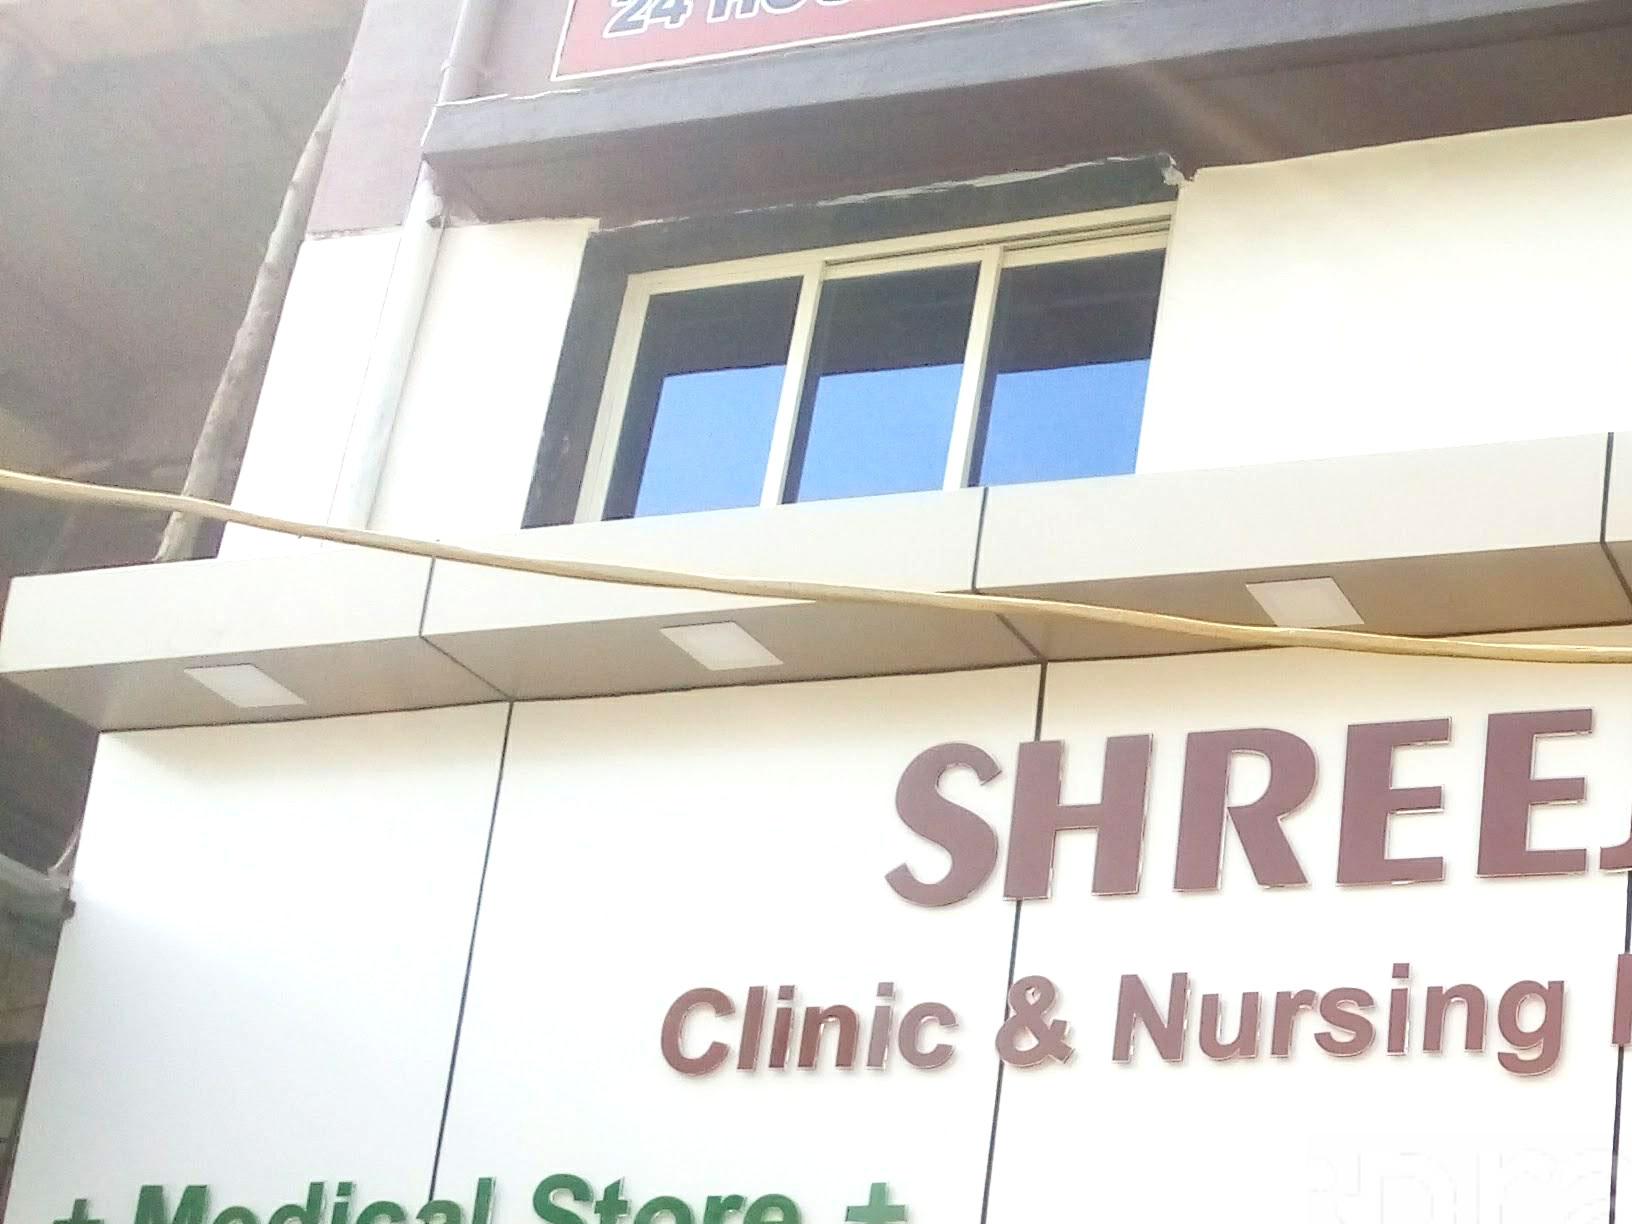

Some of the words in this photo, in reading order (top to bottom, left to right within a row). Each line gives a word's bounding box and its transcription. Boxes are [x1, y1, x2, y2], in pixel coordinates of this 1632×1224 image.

[661, 982, 958, 1078] Clinic
[995, 976, 1075, 1070] &
[1112, 962, 1566, 1078] Nursing
